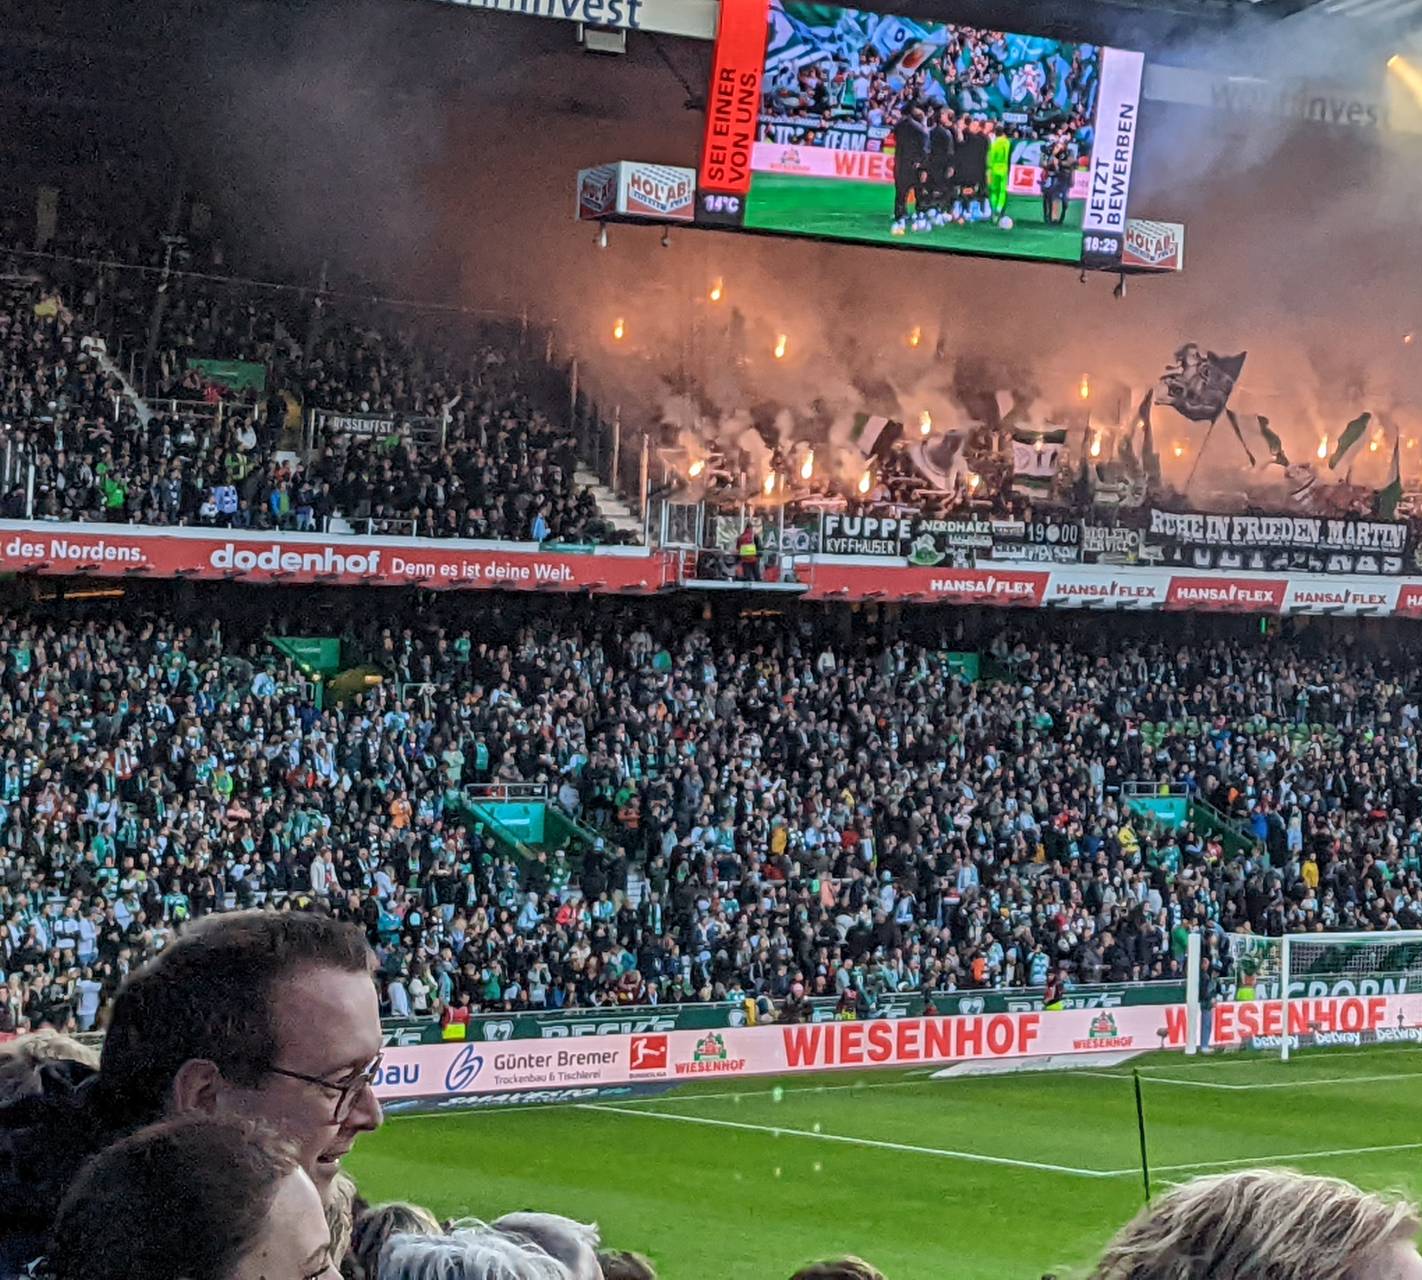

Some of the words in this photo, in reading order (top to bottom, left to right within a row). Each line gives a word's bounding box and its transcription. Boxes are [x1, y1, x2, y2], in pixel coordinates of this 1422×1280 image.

[713, 67, 736, 137] EINER
[735, 68, 757, 125] UNS.
[708, 144, 727, 182] SEI
[728, 132, 749, 184] VON
[1106, 103, 1134, 225] BEWERBEN
[1090, 157, 1109, 224] JETZT
[1084, 236, 1118, 252] 18:29
[824, 514, 911, 539] FUPPE
[1150, 508, 1204, 540] RUHE
[1205, 516, 1230, 541] IN
[1326, 522, 1408, 549] MARTIN!
[6, 538, 44, 558] des
[50, 539, 148, 562] Nordens.
[210, 544, 380, 574] dodenhof
[391, 558, 435, 577] Denn
[440, 563, 459, 578] es
[462, 561, 481, 579] ist
[484, 561, 530, 581] deine
[533, 562, 575, 582] Welt.
[1166, 997, 1388, 1046] WESENHOF
[1376, 1027, 1422, 1043] betway
[783, 1013, 1041, 1068] WIESENHOF
[1315, 1031, 1361, 1047] betway
[494, 1053, 553, 1071] Günter
[557, 1051, 620, 1067] Bremer
[675, 1059, 746, 1074] WIESENHOF
[494, 1073, 547, 1085] Trockenbau
